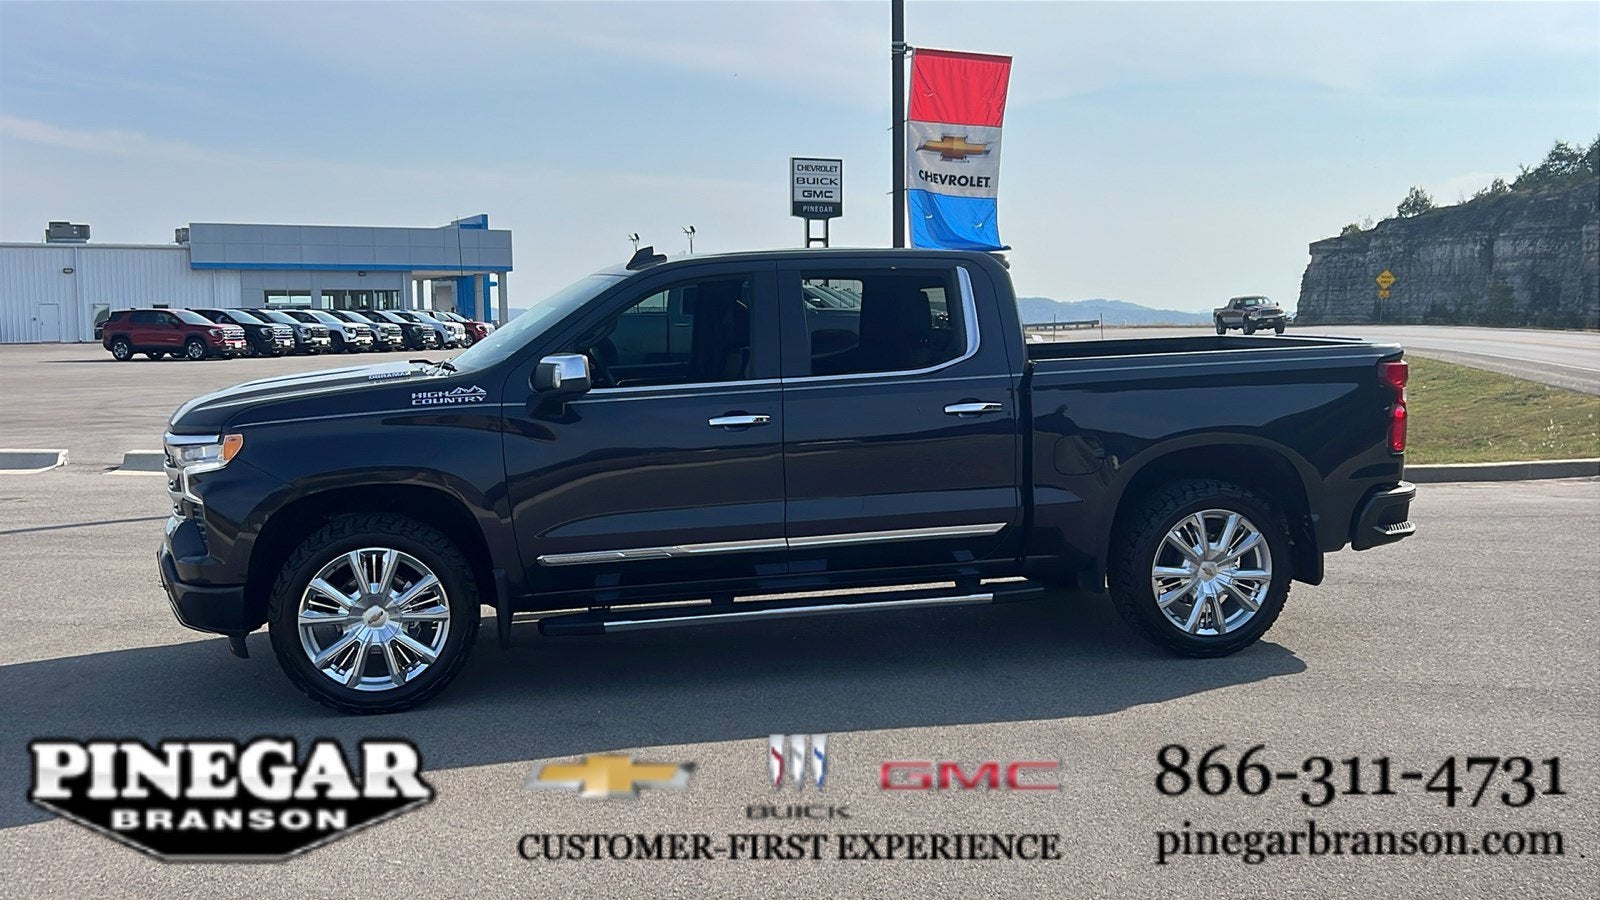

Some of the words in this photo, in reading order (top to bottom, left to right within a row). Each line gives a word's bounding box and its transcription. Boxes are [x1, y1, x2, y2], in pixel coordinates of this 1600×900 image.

[797, 164, 838, 173] CHEVROLET
[796, 177, 838, 186] BUICK
[918, 169, 991, 188] CHEVROLET
[802, 190, 833, 198] GMC
[802, 205, 833, 213] PINEGAR
[411, 390, 450, 399] HIGH
[411, 395, 486, 406] COUNTRY
